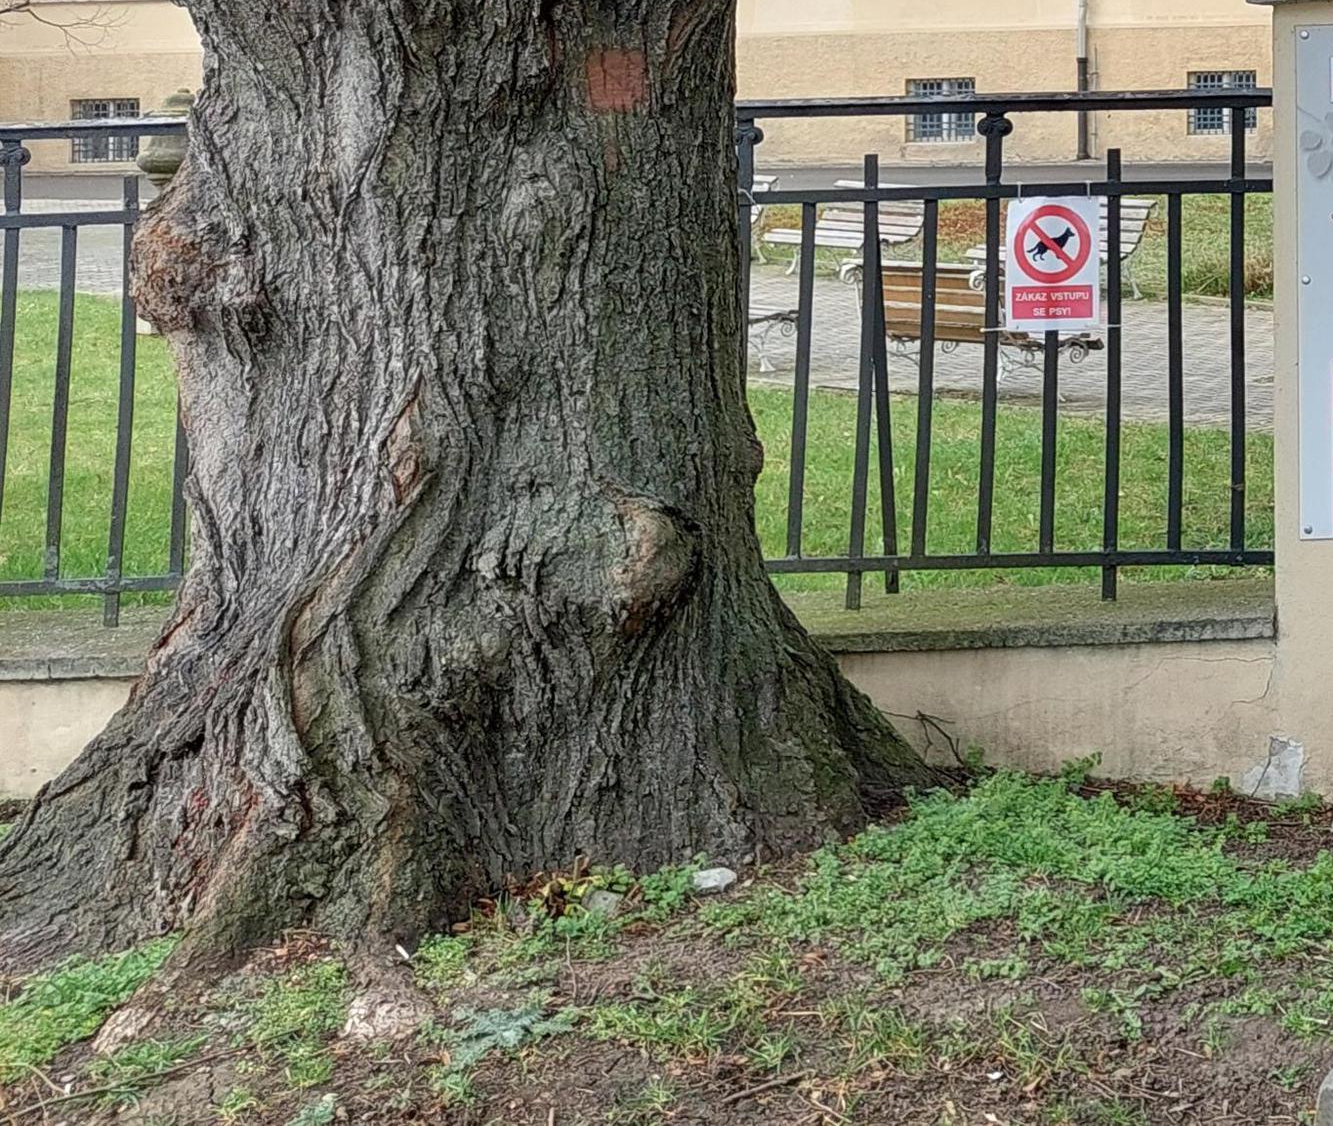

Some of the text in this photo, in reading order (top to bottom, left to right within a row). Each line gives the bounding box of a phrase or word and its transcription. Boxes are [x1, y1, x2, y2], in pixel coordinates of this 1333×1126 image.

[1015, 290, 1089, 302] ZÁKAZ VSTUPU
[1032, 307, 1072, 316] SE PSY!
